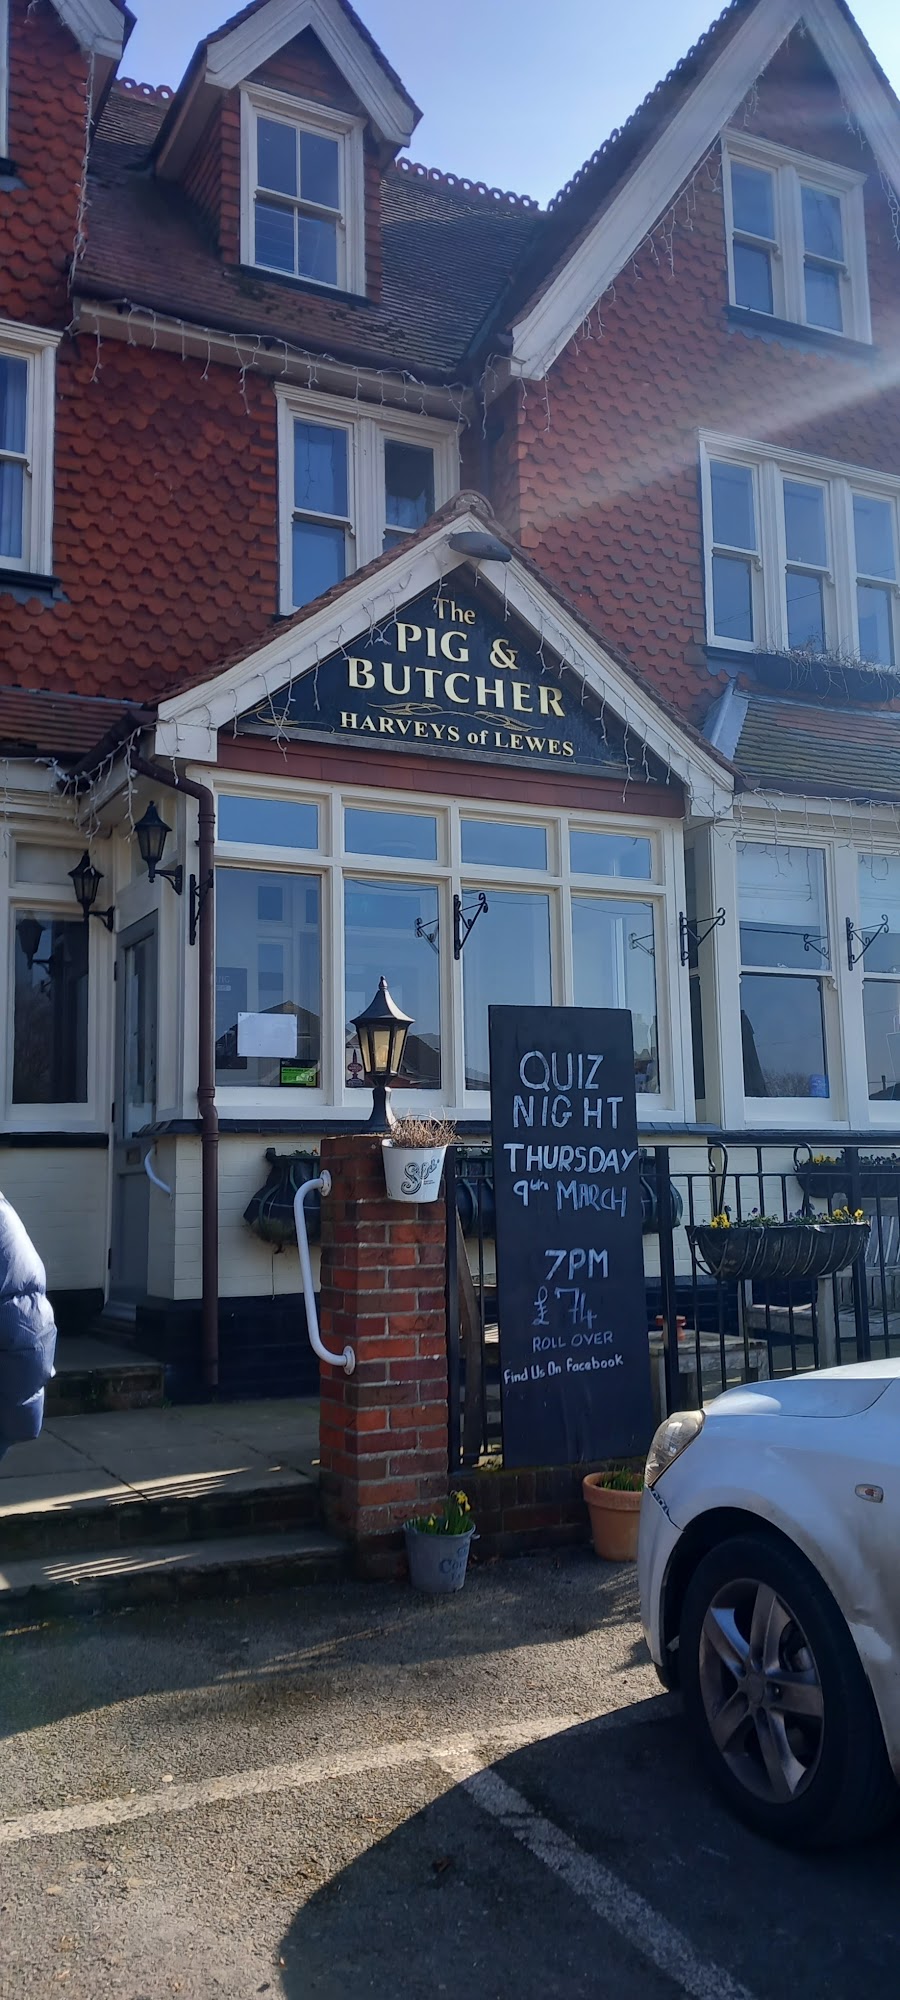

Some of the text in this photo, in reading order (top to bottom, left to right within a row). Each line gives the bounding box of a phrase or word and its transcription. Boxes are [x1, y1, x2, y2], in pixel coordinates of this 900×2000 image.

[432, 597, 475, 625] The
[396, 622, 519, 670] PIG &
[348, 657, 566, 717] BUTCHER
[339, 711, 574, 757] HARVEYS of LEWES
[519, 1050, 604, 1092] QUIZ
[513, 1094, 623, 1129] NIGHT
[503, 1143, 638, 1174] THURSDAY
[513, 1178, 627, 1217] 9th MARCH
[544, 1248, 609, 1280] 7PM
[532, 1330, 614, 1353] ROLL OVER
[547, 1360, 562, 1377] On
